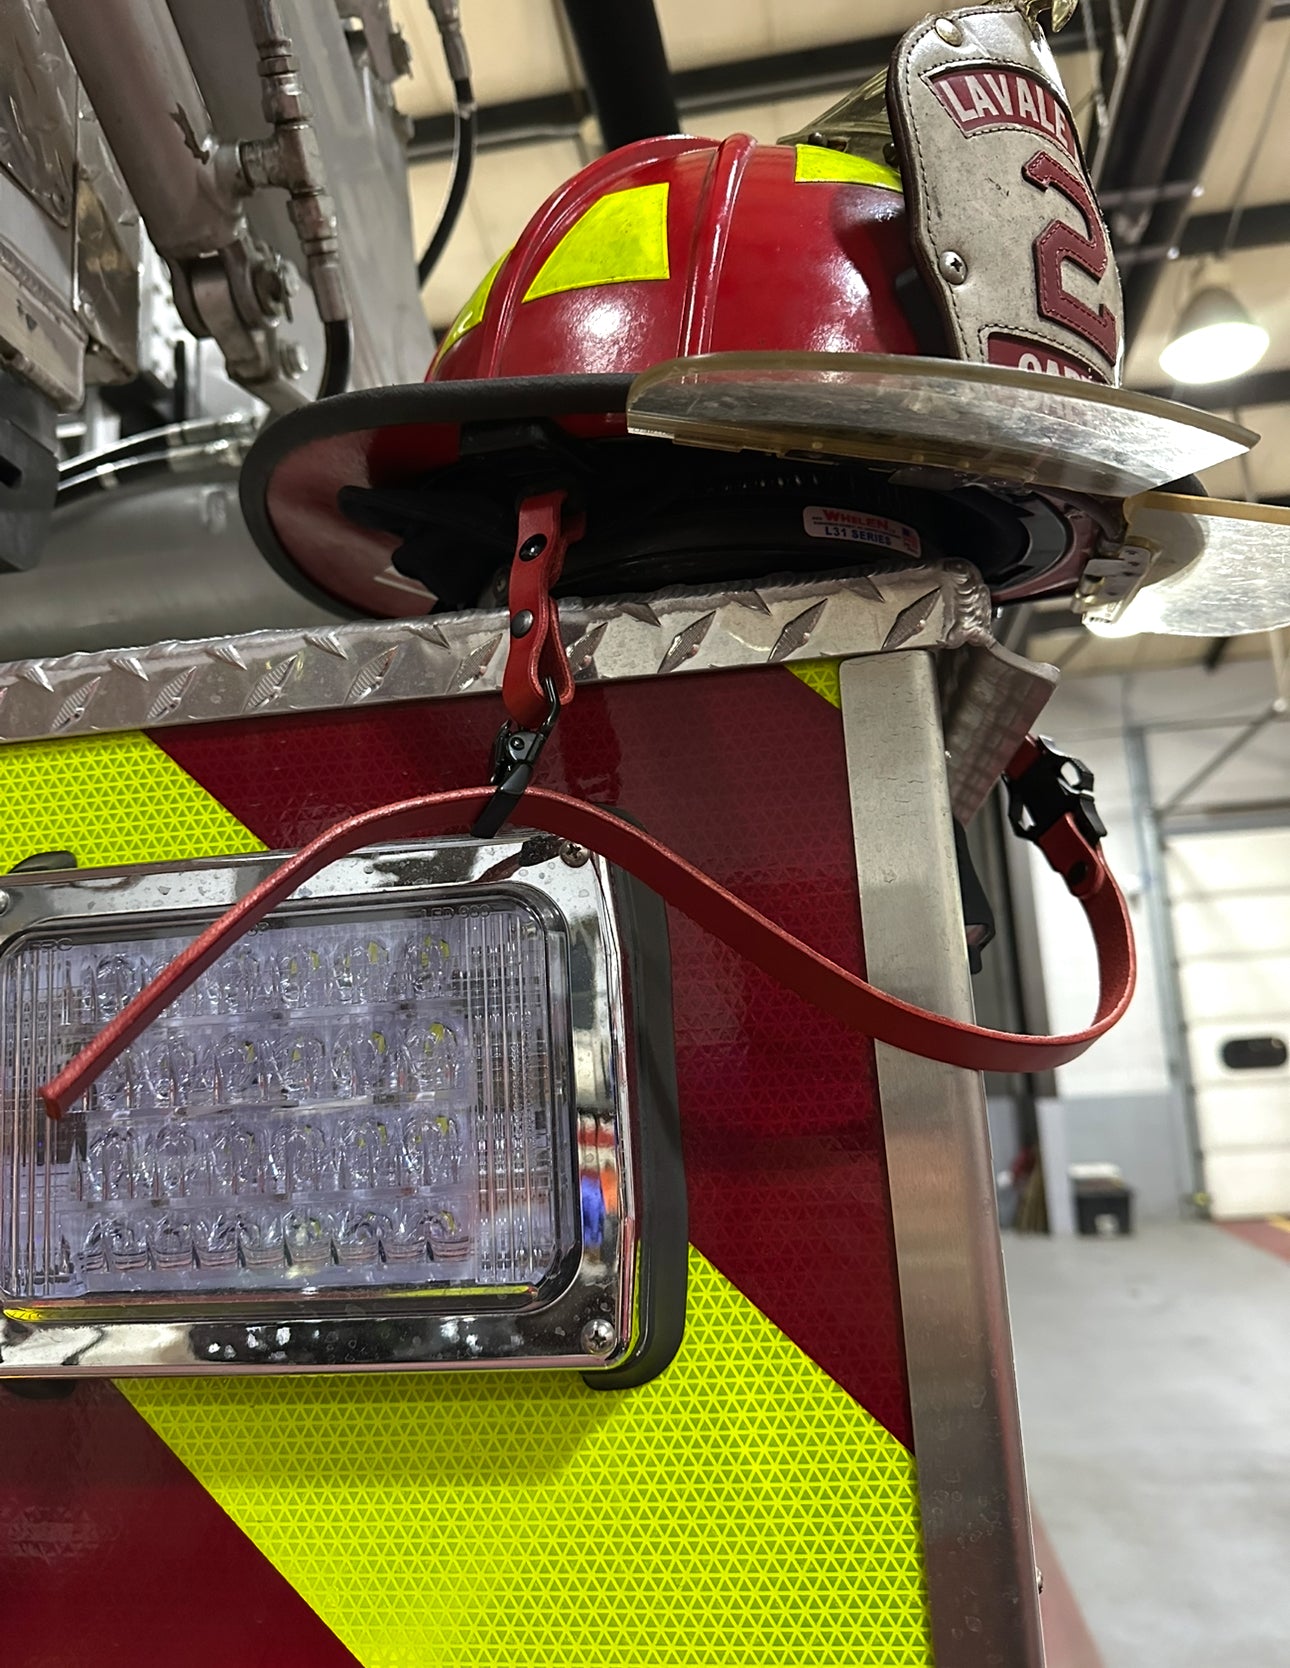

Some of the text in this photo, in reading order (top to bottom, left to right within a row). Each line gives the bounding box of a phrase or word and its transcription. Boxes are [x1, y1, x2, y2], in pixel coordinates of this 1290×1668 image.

[938, 73, 1069, 150] LAVALE
[1021, 150, 1118, 367] 2
[822, 509, 889, 530] WHELEN
[825, 526, 847, 538] L31
[851, 529, 892, 546] SERIES
